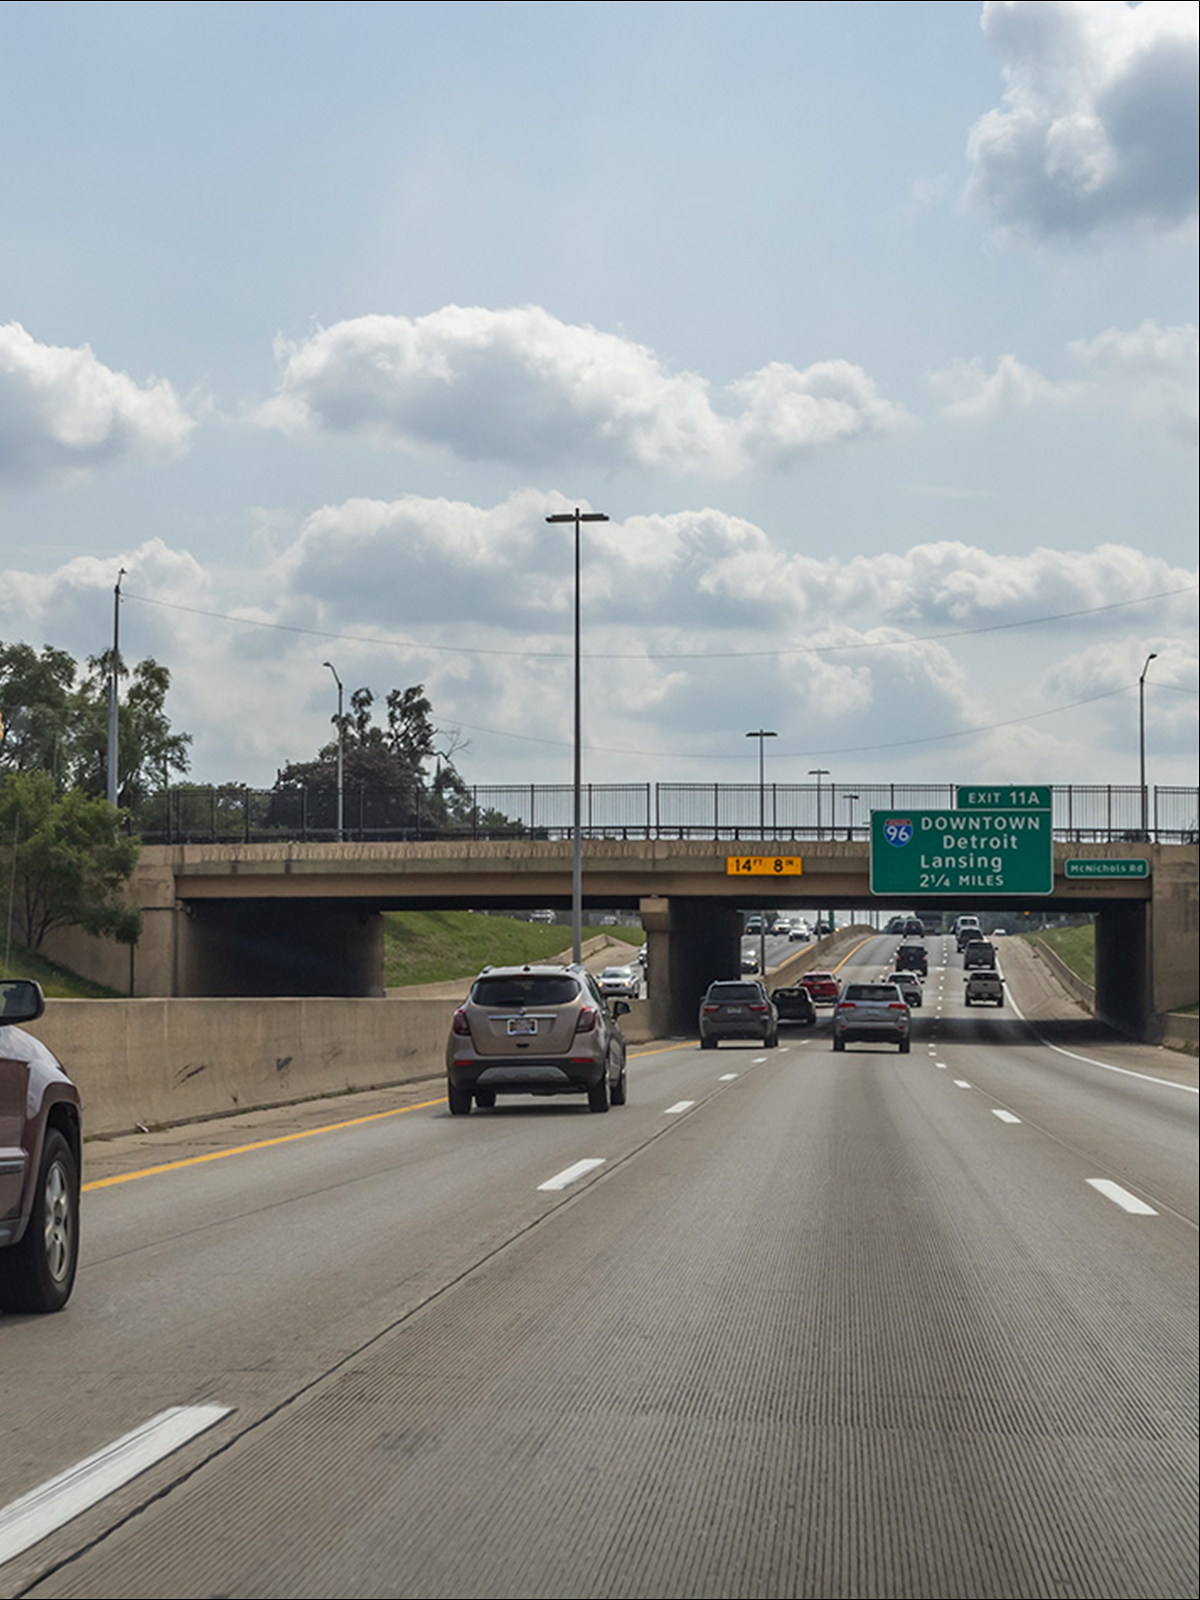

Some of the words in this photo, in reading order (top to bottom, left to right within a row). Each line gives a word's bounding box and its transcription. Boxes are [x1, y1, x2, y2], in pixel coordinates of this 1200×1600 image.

[968, 792, 1000, 804] EXIT
[1010, 791, 1040, 804] 11A
[921, 816, 1040, 831] DOWNTOWN
[886, 825, 910, 842] 96
[943, 834, 1018, 850] Detroit
[920, 854, 1003, 873] Lansing
[1070, 863, 1126, 873] McNichols
[1129, 863, 1143, 873] Rd
[958, 874, 1004, 886] MILES
